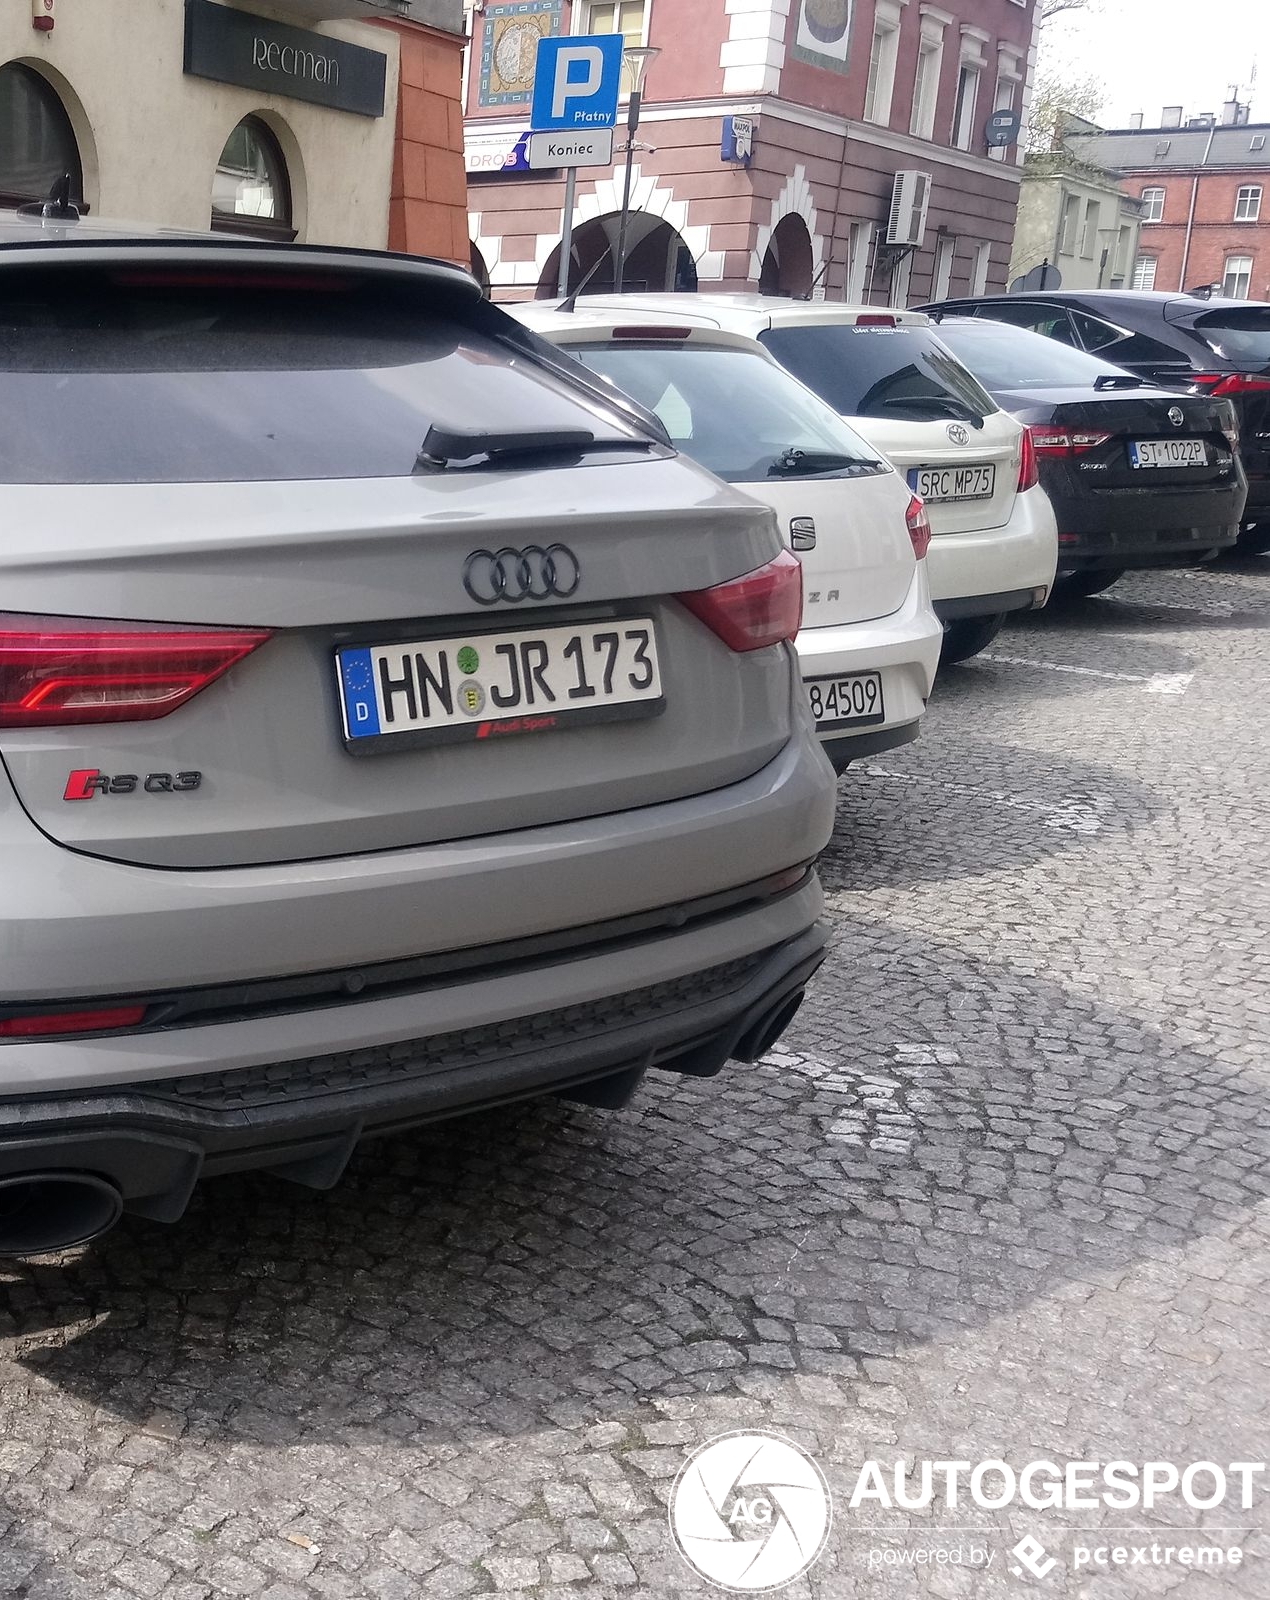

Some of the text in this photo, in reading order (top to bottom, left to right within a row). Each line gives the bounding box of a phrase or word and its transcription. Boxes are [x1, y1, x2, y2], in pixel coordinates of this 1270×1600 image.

[573, 111, 612, 124] Płatny
[547, 142, 593, 157] Koniec
[1139, 442, 1202, 462] ST 1022P
[920, 468, 991, 496] SRC MP75
[378, 650, 454, 723] HN
[809, 679, 878, 720] 84509
[356, 701, 369, 721] D
[491, 715, 557, 733] Audi Sport
[83, 771, 203, 795] RS Q3
